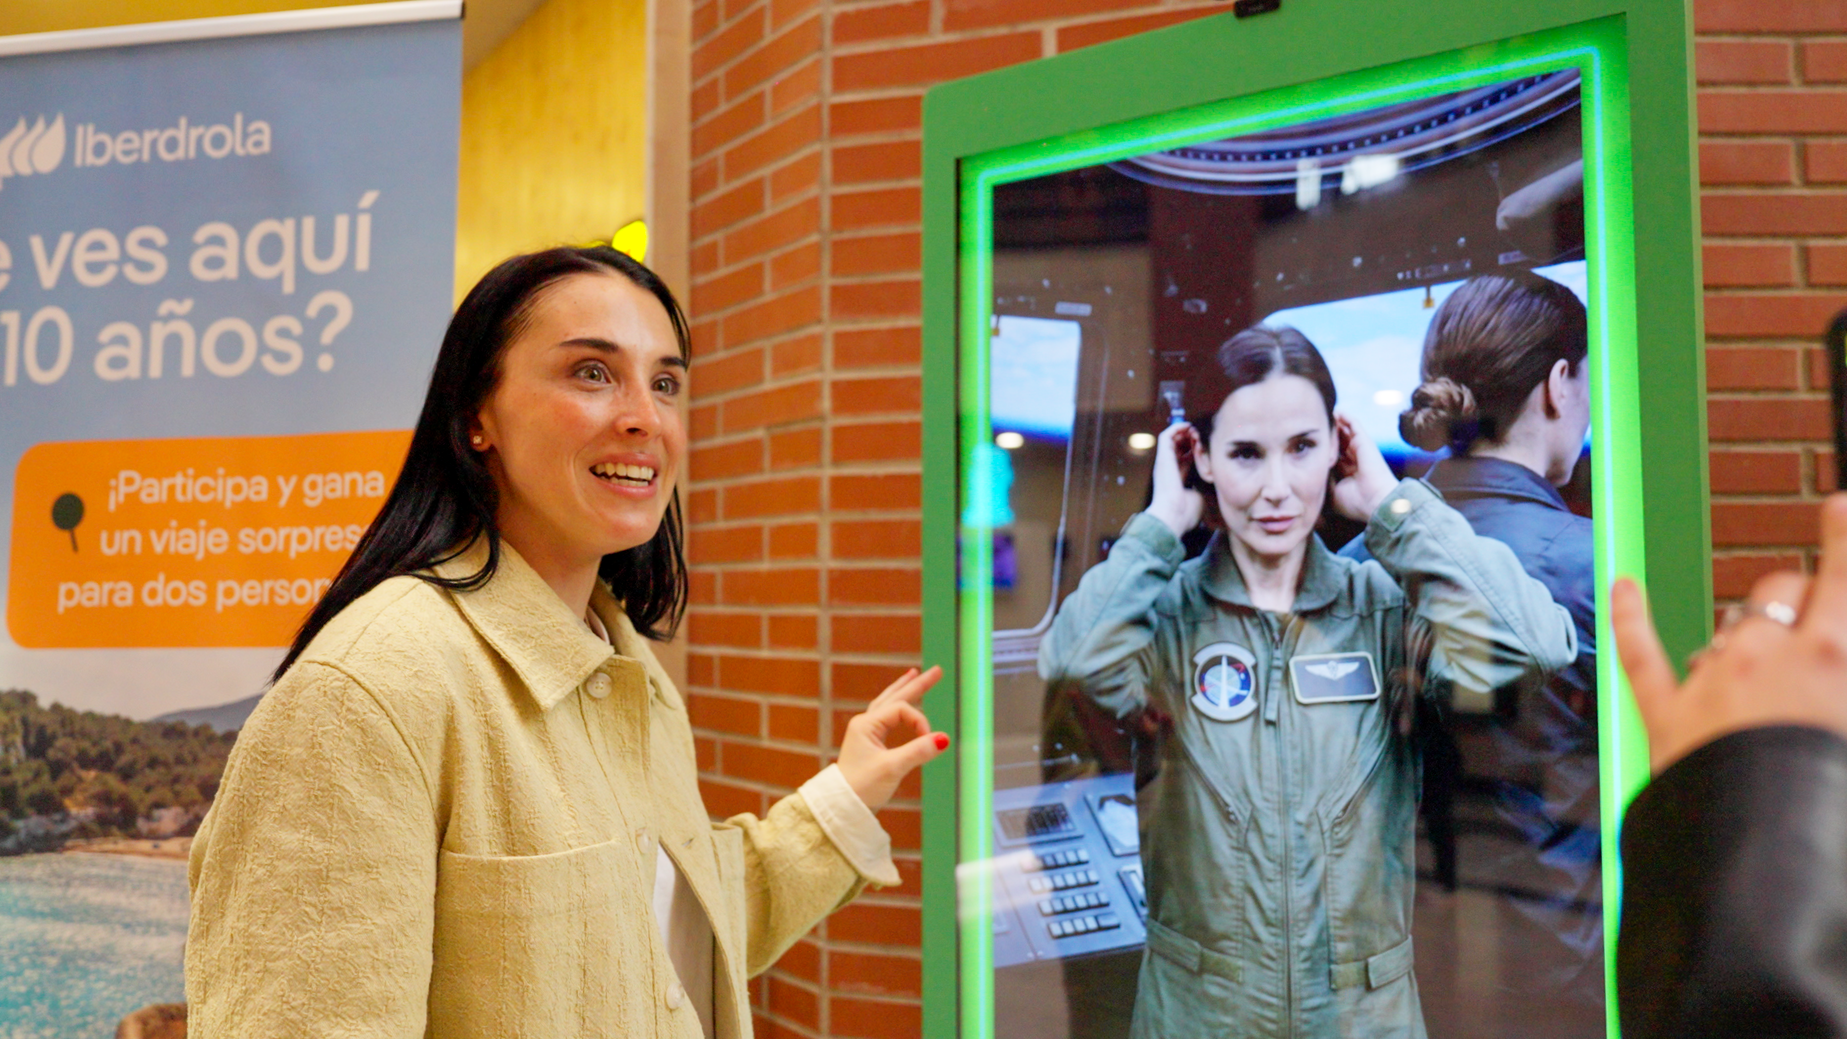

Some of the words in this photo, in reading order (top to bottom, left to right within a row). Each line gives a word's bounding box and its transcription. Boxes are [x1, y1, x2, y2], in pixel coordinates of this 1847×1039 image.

[75, 112, 271, 167] Iberdrola
[29, 225, 169, 289] ves
[189, 190, 381, 295] aquí
[0, 306, 74, 387] 10
[94, 290, 354, 381] años?
[107, 469, 268, 512] ¡Participa
[278, 476, 297, 507] y
[303, 470, 384, 507] gana
[101, 527, 142, 556] un
[149, 521, 229, 561] viaje
[237, 523, 366, 559] sorpres
[57, 580, 134, 614] para
[141, 573, 207, 607] dos
